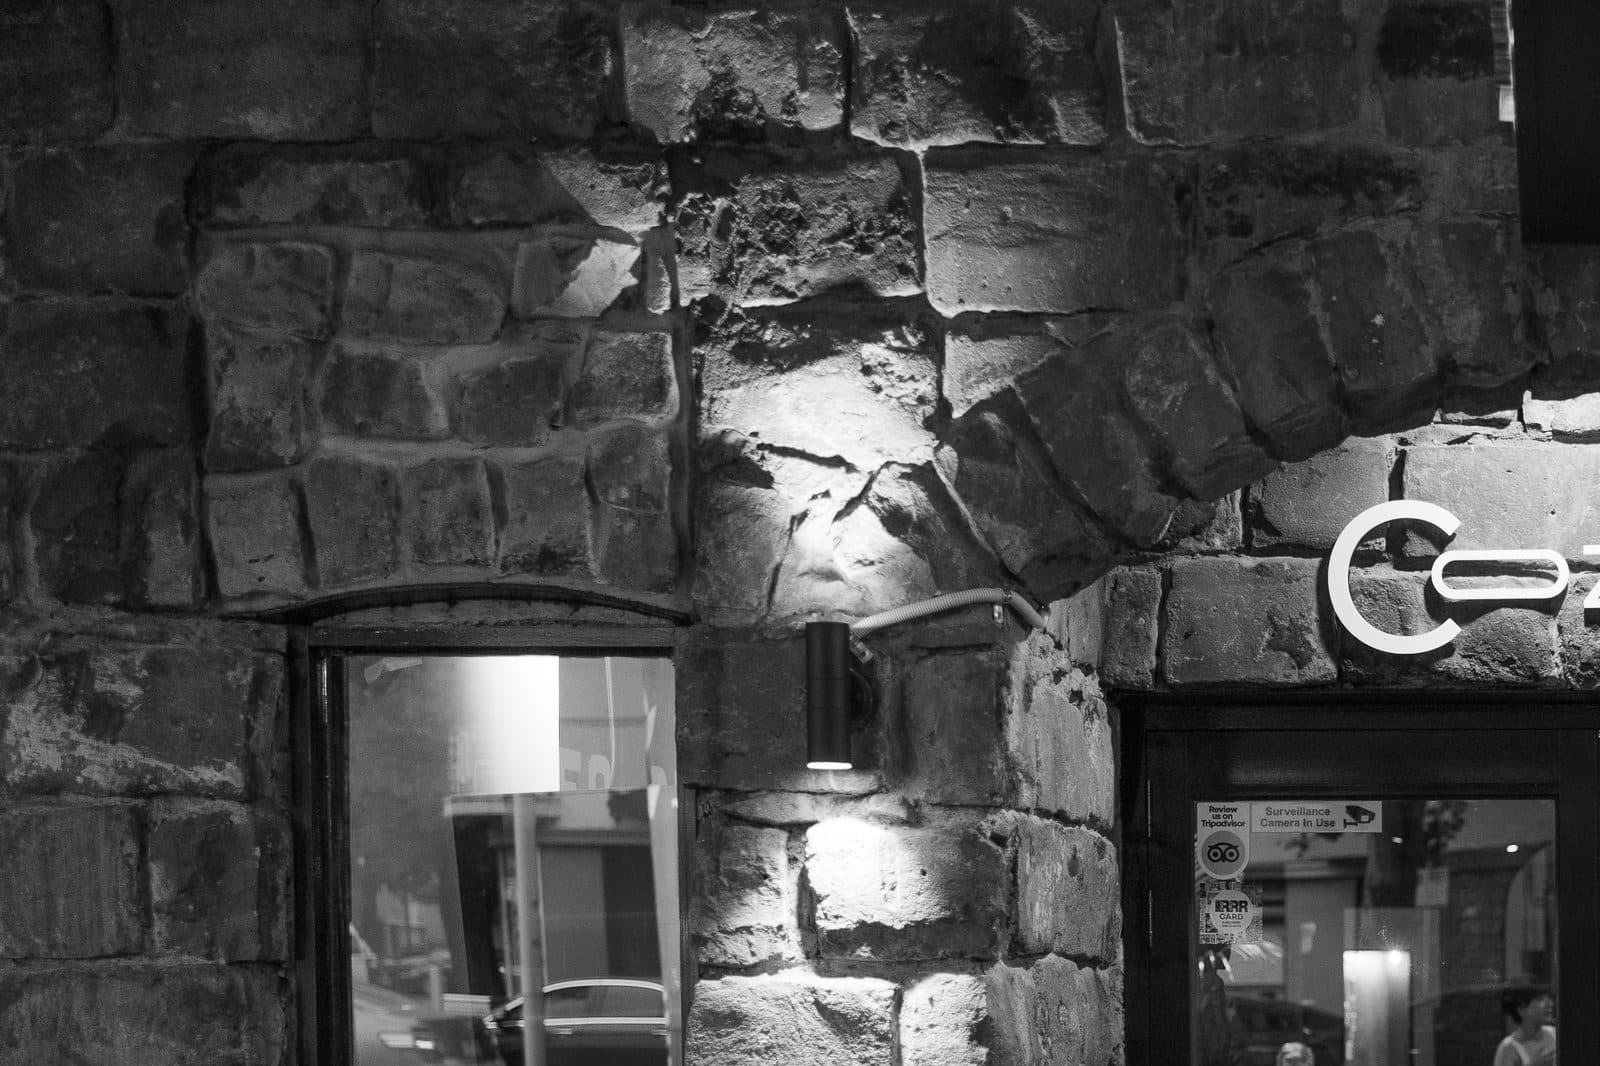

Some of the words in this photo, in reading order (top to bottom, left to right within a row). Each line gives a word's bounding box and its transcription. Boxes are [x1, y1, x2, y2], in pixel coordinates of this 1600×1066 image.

[1208, 805, 1238, 813] Review
[1265, 806, 1331, 817] Surveillance
[1201, 819, 1245, 829] Tripadvisor
[1260, 818, 1300, 828] Camera
[1303, 818, 1312, 828] In
[1315, 818, 1336, 828] Use
[1219, 913, 1244, 921] CARD
